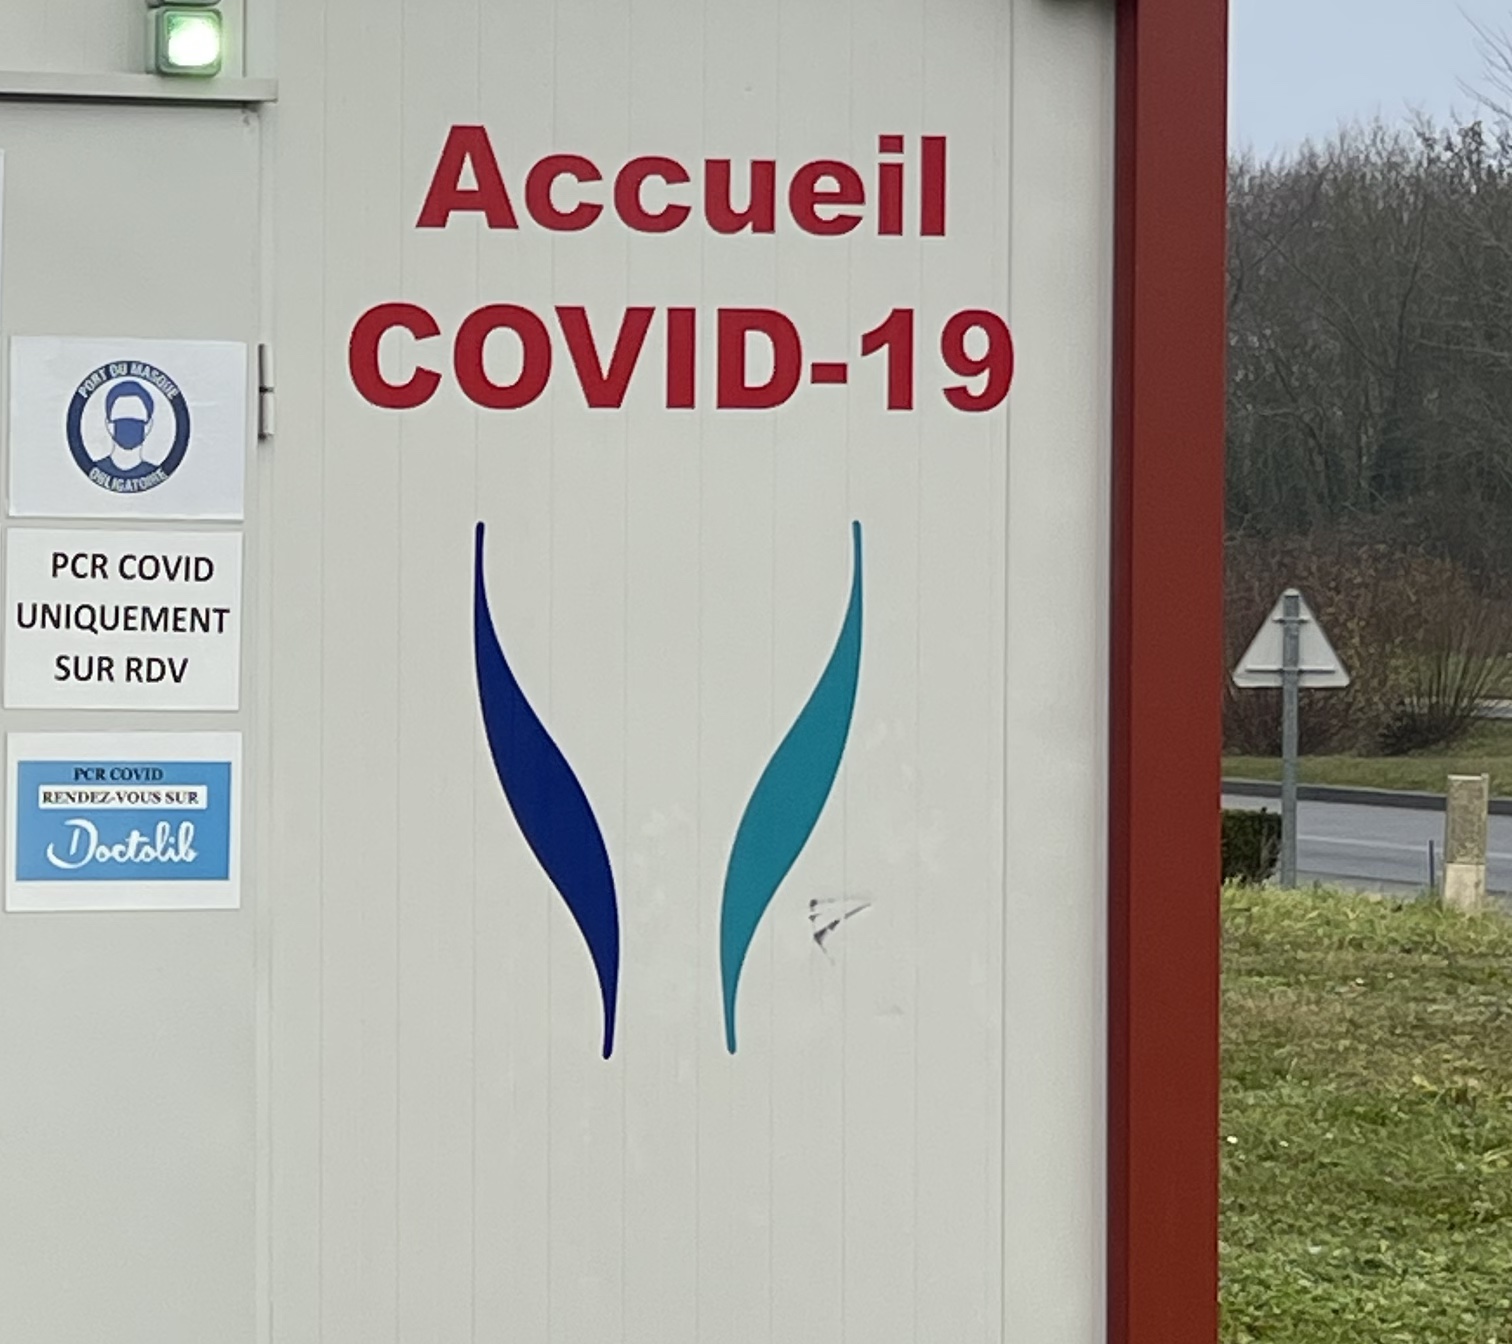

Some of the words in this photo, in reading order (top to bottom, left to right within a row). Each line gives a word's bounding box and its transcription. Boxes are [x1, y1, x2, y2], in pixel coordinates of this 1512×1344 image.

[415, 124, 947, 237] Accueil
[348, 302, 1015, 413] COVID-19
[78, 368, 107, 398] PORT
[109, 362, 128, 376] DU
[130, 362, 180, 400] MASQUE
[89, 467, 169, 492] OBLIGATOIRE
[51, 551, 109, 580] PCR
[118, 553, 214, 582] COVID
[16, 602, 230, 635] UNIQUEMENT
[54, 654, 115, 682] SUR
[125, 656, 189, 683] RDV
[73, 766, 106, 782] PCR
[109, 767, 164, 782] COVID
[42, 791, 161, 805] RENDEZ-VOUS
[165, 791, 199, 805] SUR
[46, 818, 199, 869] Doctolib
